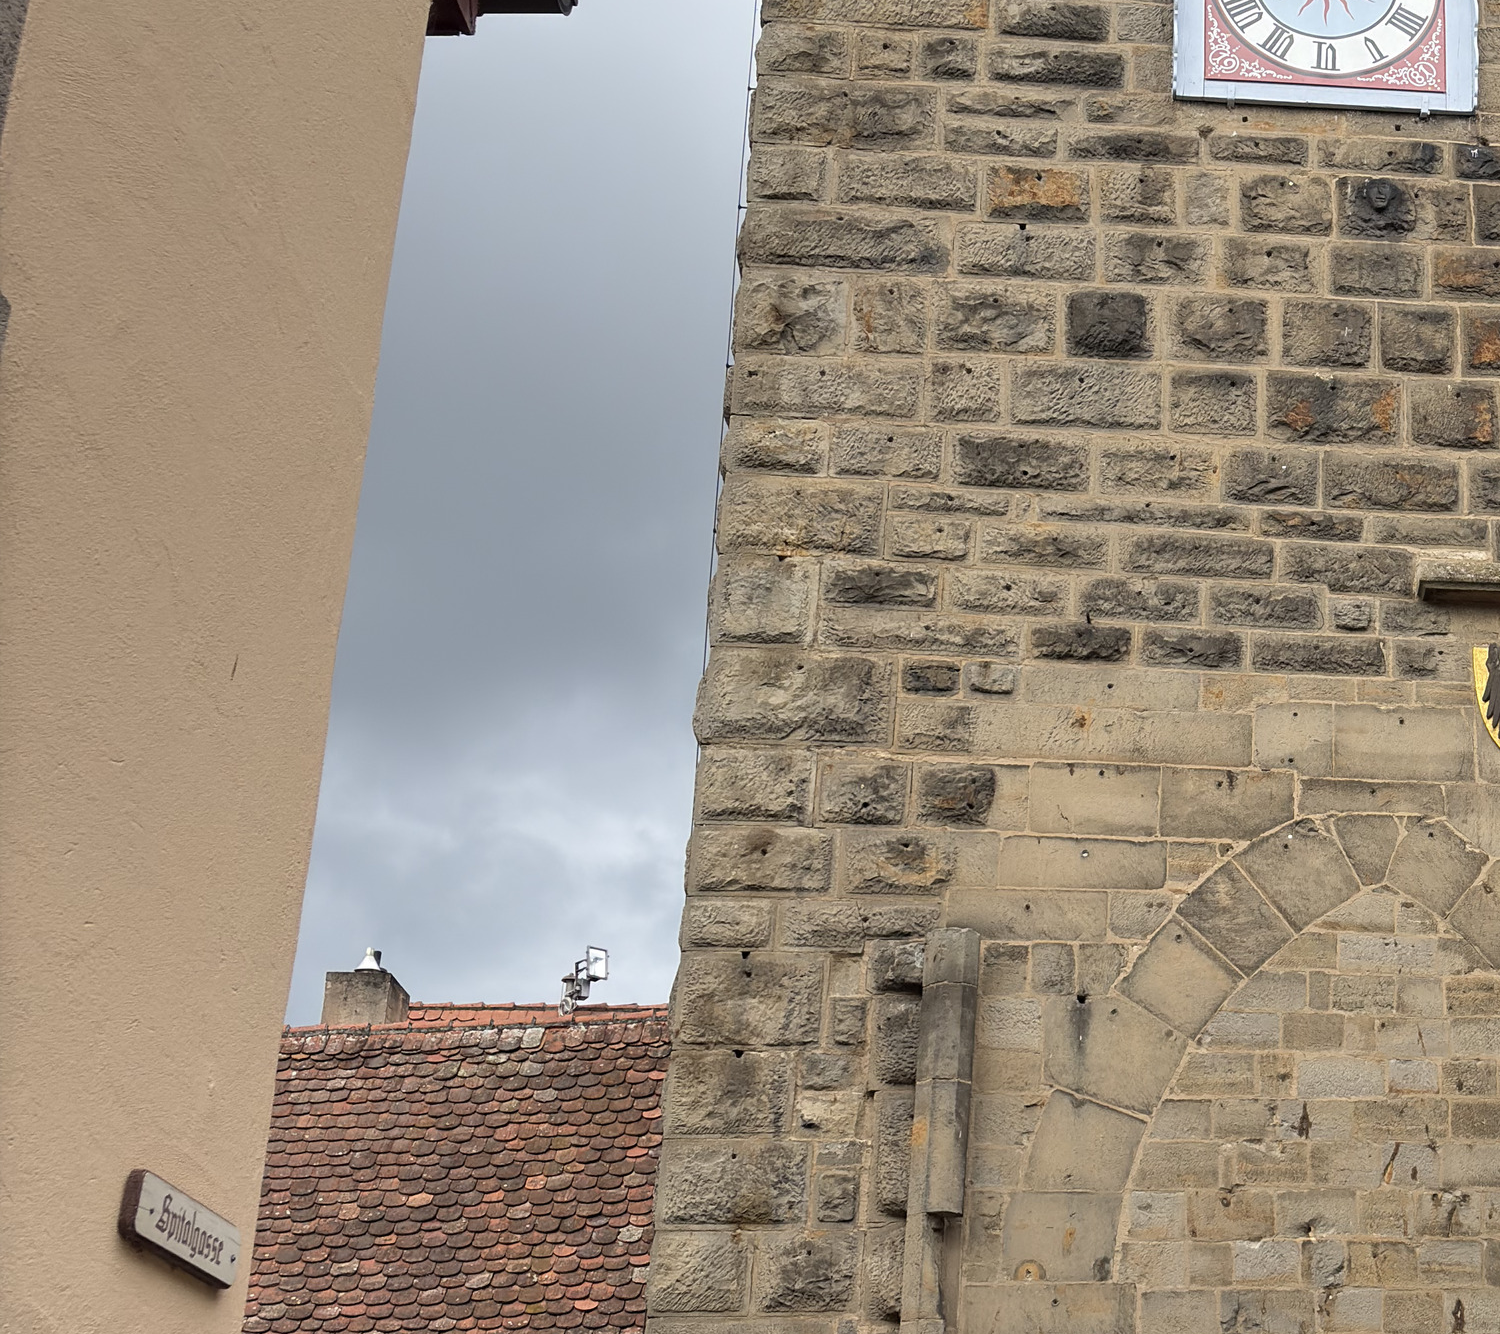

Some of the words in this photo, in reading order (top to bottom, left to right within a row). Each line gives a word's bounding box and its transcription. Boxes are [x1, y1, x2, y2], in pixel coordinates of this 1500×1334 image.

[1385, 3, 1428, 42] IIII
[1256, 23, 1295, 62] VII
[1311, 41, 1340, 72] VI
[1364, 36, 1389, 64] V
[155, 1193, 225, 1266] Spitalgasse
